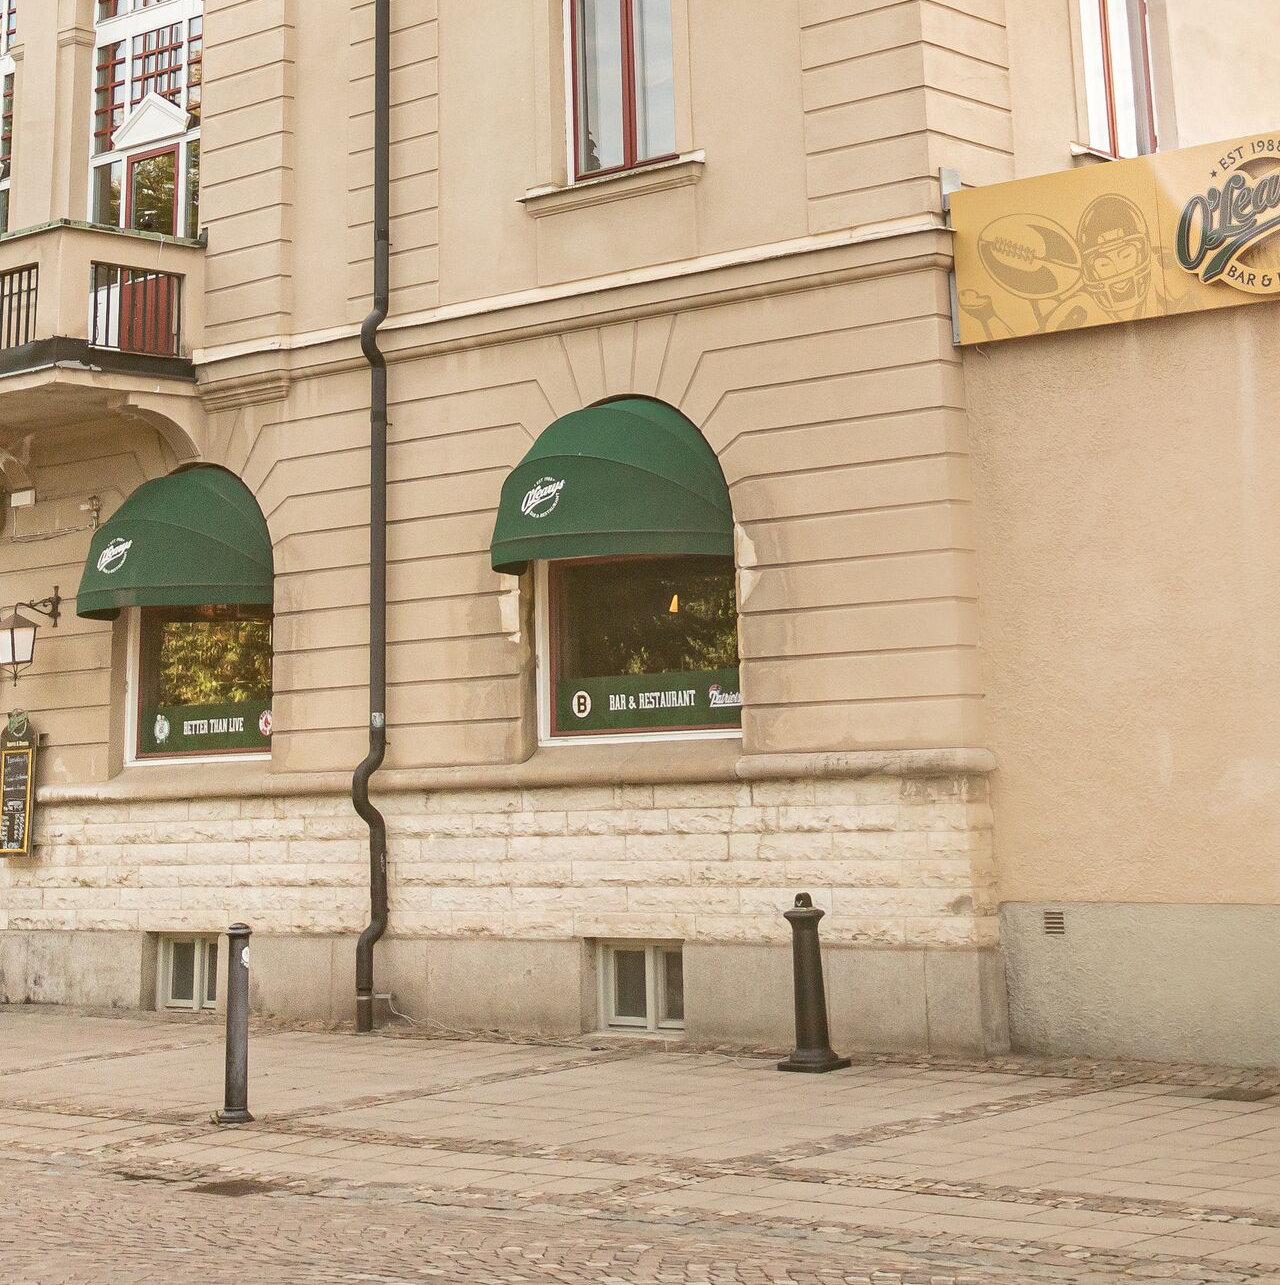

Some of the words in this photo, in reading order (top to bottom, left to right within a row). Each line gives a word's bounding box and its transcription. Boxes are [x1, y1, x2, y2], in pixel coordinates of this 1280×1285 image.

[1218, 146, 1245, 171] EST
[1226, 265, 1256, 287] BAR
[1261, 274, 1273, 287] &
[609, 694, 627, 711] BAR
[628, 695, 637, 710] &
[639, 689, 696, 709] RESTAURANT
[183, 720, 209, 735] BETTER
[209, 718, 228, 733] THAN
[228, 717, 245, 732] LIVE
